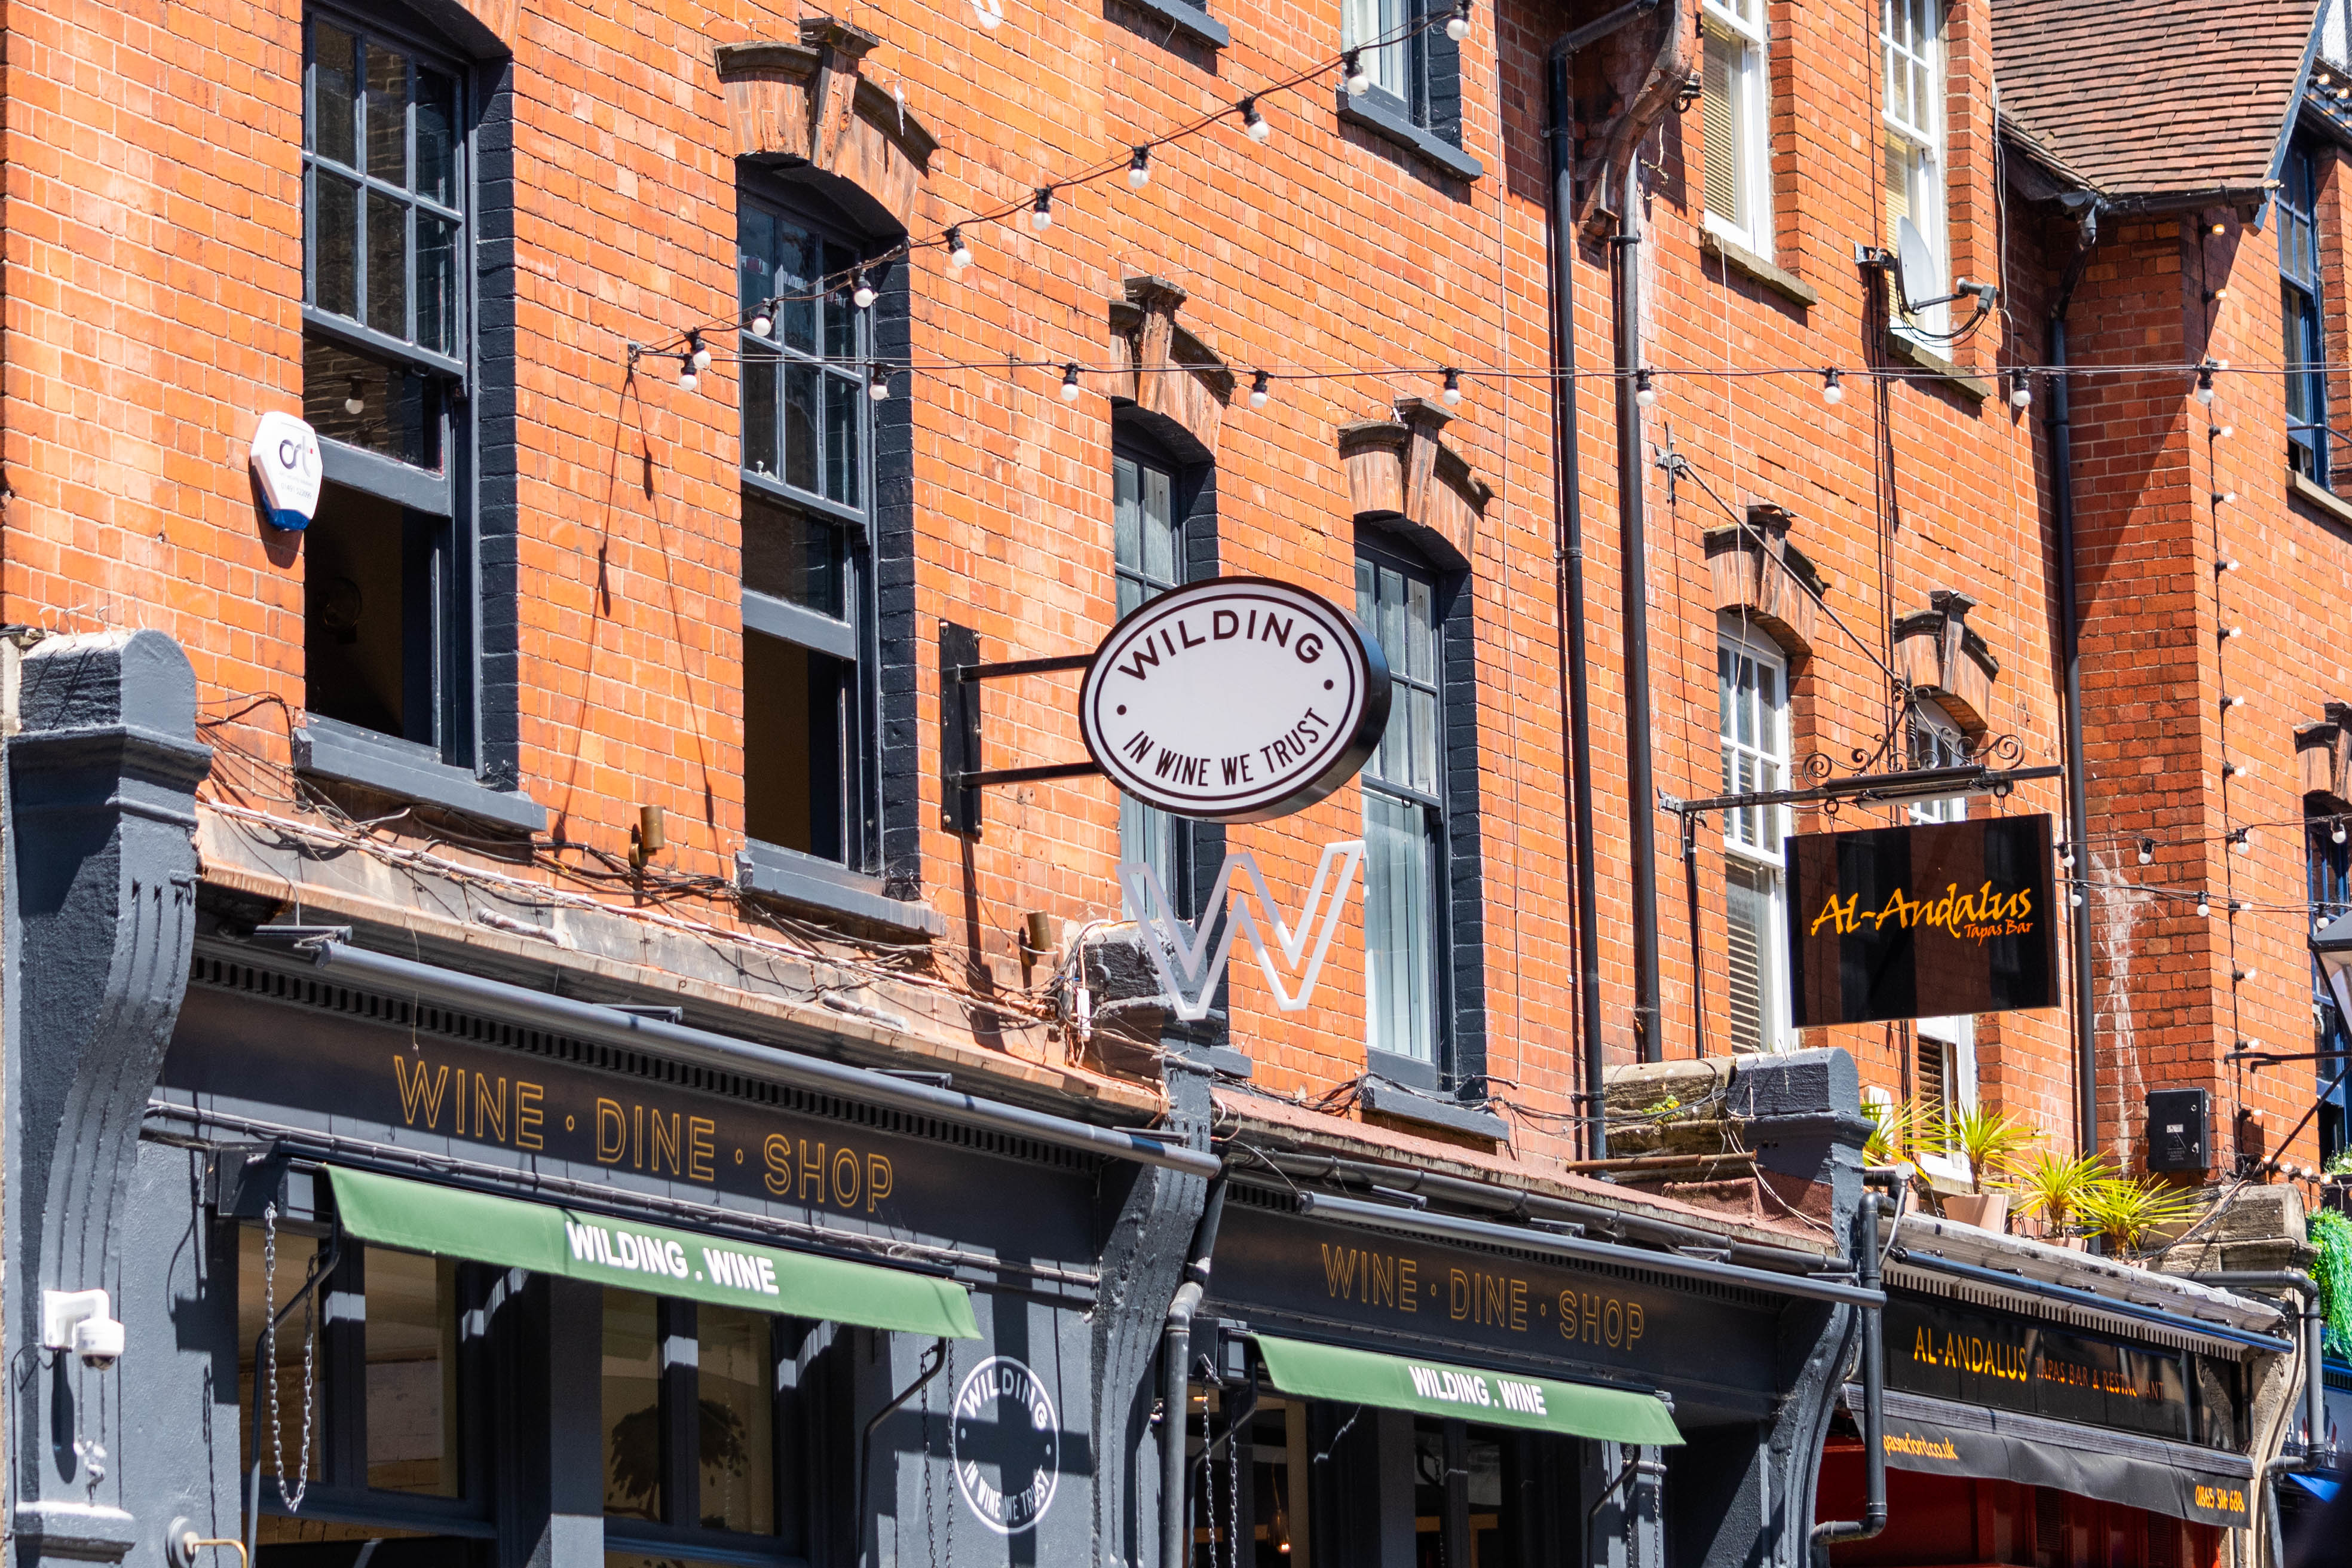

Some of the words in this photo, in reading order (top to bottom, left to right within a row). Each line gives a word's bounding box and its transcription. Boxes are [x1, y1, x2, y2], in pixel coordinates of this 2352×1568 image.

[1117, 610, 1324, 681] WILDING
[1123, 730, 1154, 764] IN
[1154, 748, 1211, 787] WINE
[1221, 753, 1254, 786] WE
[1260, 707, 1330, 773] TRUST
[1114, 840, 1366, 1021] W
[1964, 923, 2002, 947] Tapas
[2004, 918, 2034, 935] Bar
[393, 1055, 544, 1151] WINE
[597, 1097, 715, 1182] DINE
[764, 1133, 893, 1213] SHOP
[565, 1221, 690, 1279] WILDING
[1321, 1243, 1417, 1312] WINE
[1450, 1268, 1527, 1332] DINE
[1558, 1290, 1644, 1351] SHOP
[1408, 1365, 1491, 1407] WILDING
[1913, 1325, 2028, 1382] AL-ANDALUS
[2035, 1356, 2066, 1384] TAPAS
[2069, 1364, 2088, 1387] BAR
[2092, 1368, 2100, 1390] &
[962, 1367, 1048, 1431] WILDING
[1883, 1432, 1959, 1460] pasoxford.co.uk
[963, 1459, 979, 1489] IN
[977, 1475, 1002, 1520] WINE
[1004, 1494, 1019, 1521] WE
[1020, 1464, 1050, 1517] TRUST
[2195, 1485, 2215, 1509] 01865
[2216, 1487, 2229, 1510] 516
[2229, 1490, 2245, 1512] 688
